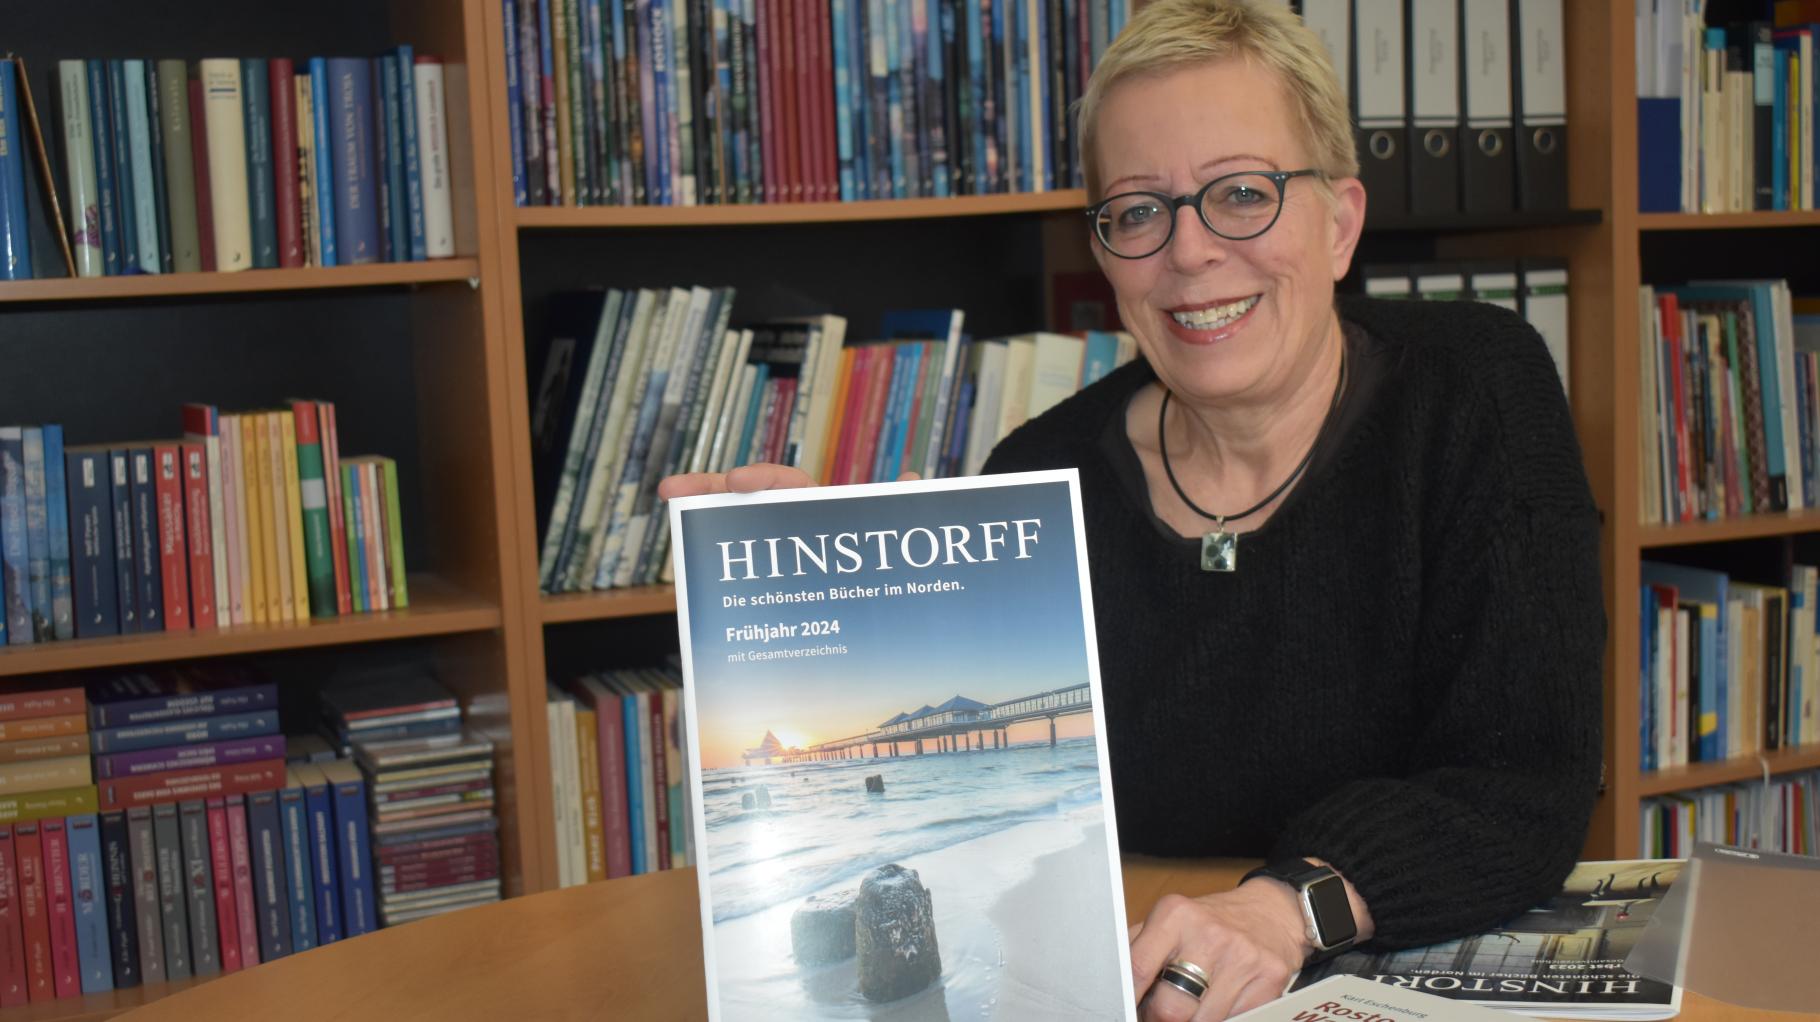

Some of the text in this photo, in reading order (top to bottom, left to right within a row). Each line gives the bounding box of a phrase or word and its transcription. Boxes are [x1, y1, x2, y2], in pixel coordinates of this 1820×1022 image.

[716, 518, 1042, 582] HINSTORFF
[722, 579, 965, 608] Die schönsten Bücher im Norden.
[725, 619, 840, 643] Frühjahr 2024
[727, 643, 848, 663] mit Gesamtverzeichnis
[1410, 968, 1465, 976] Norden.
[1489, 971, 1538, 979] Bücher
[1340, 994, 1429, 1019] Karl Eschenburg
